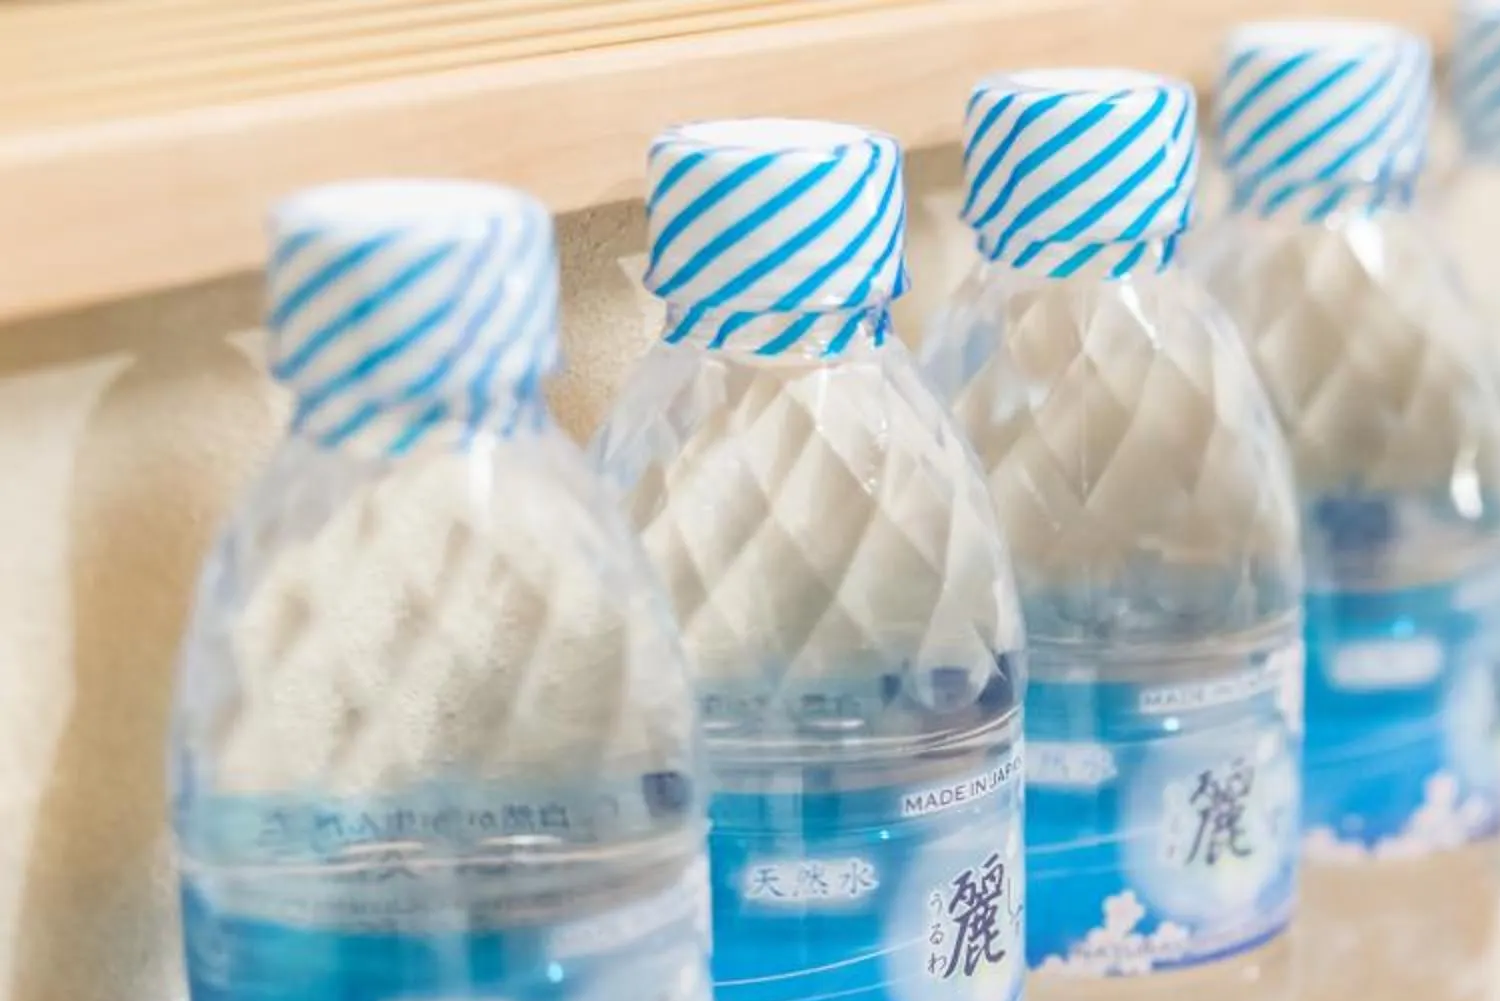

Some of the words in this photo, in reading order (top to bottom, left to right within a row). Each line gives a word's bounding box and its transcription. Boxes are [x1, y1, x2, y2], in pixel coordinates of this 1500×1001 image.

[905, 784, 967, 812] MADE
[970, 777, 987, 797] IN
[753, 862, 872, 897] 天然水
[942, 853, 1007, 979] 麗
